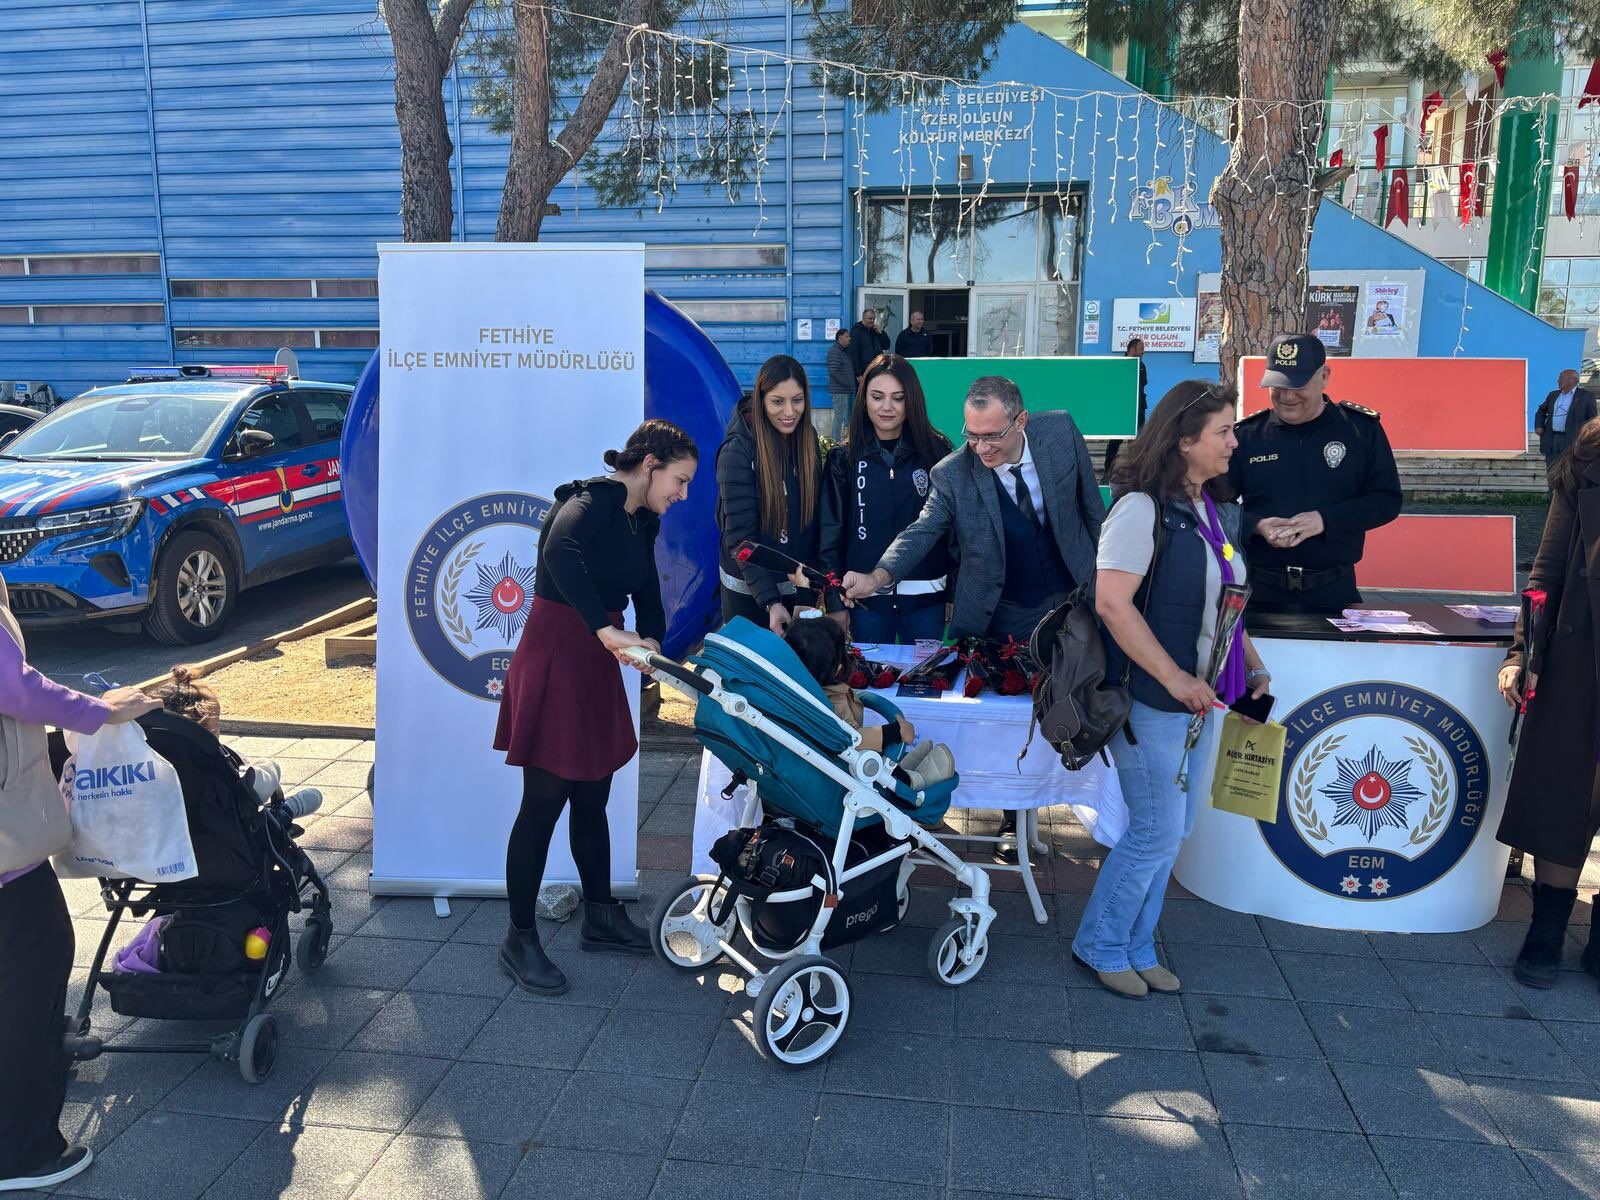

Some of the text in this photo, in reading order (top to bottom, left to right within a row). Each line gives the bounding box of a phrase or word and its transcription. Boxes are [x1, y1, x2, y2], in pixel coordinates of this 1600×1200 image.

[957, 89, 1045, 106] BELEDİYESİ
[963, 111, 1013, 124] OLGUN
[963, 127, 1028, 142] MERKEZİ
[1308, 290, 1332, 303] KÜRK
[479, 325, 554, 345] FETHİYE
[1156, 324, 1191, 332] BELEDİYESİ
[387, 348, 635, 372] İLÇE EMNİYET MÜDÜRLÜĞÜ
[414, 500, 549, 618] FETHİYE İLÇE EMNİYE
[491, 657, 511, 671] EG
[1290, 690, 1483, 827] İLÇE EMNİYET MÜDÜRLÜĞÜ
[1348, 855, 1385, 870] EGM
[846, 904, 878, 929] prego
